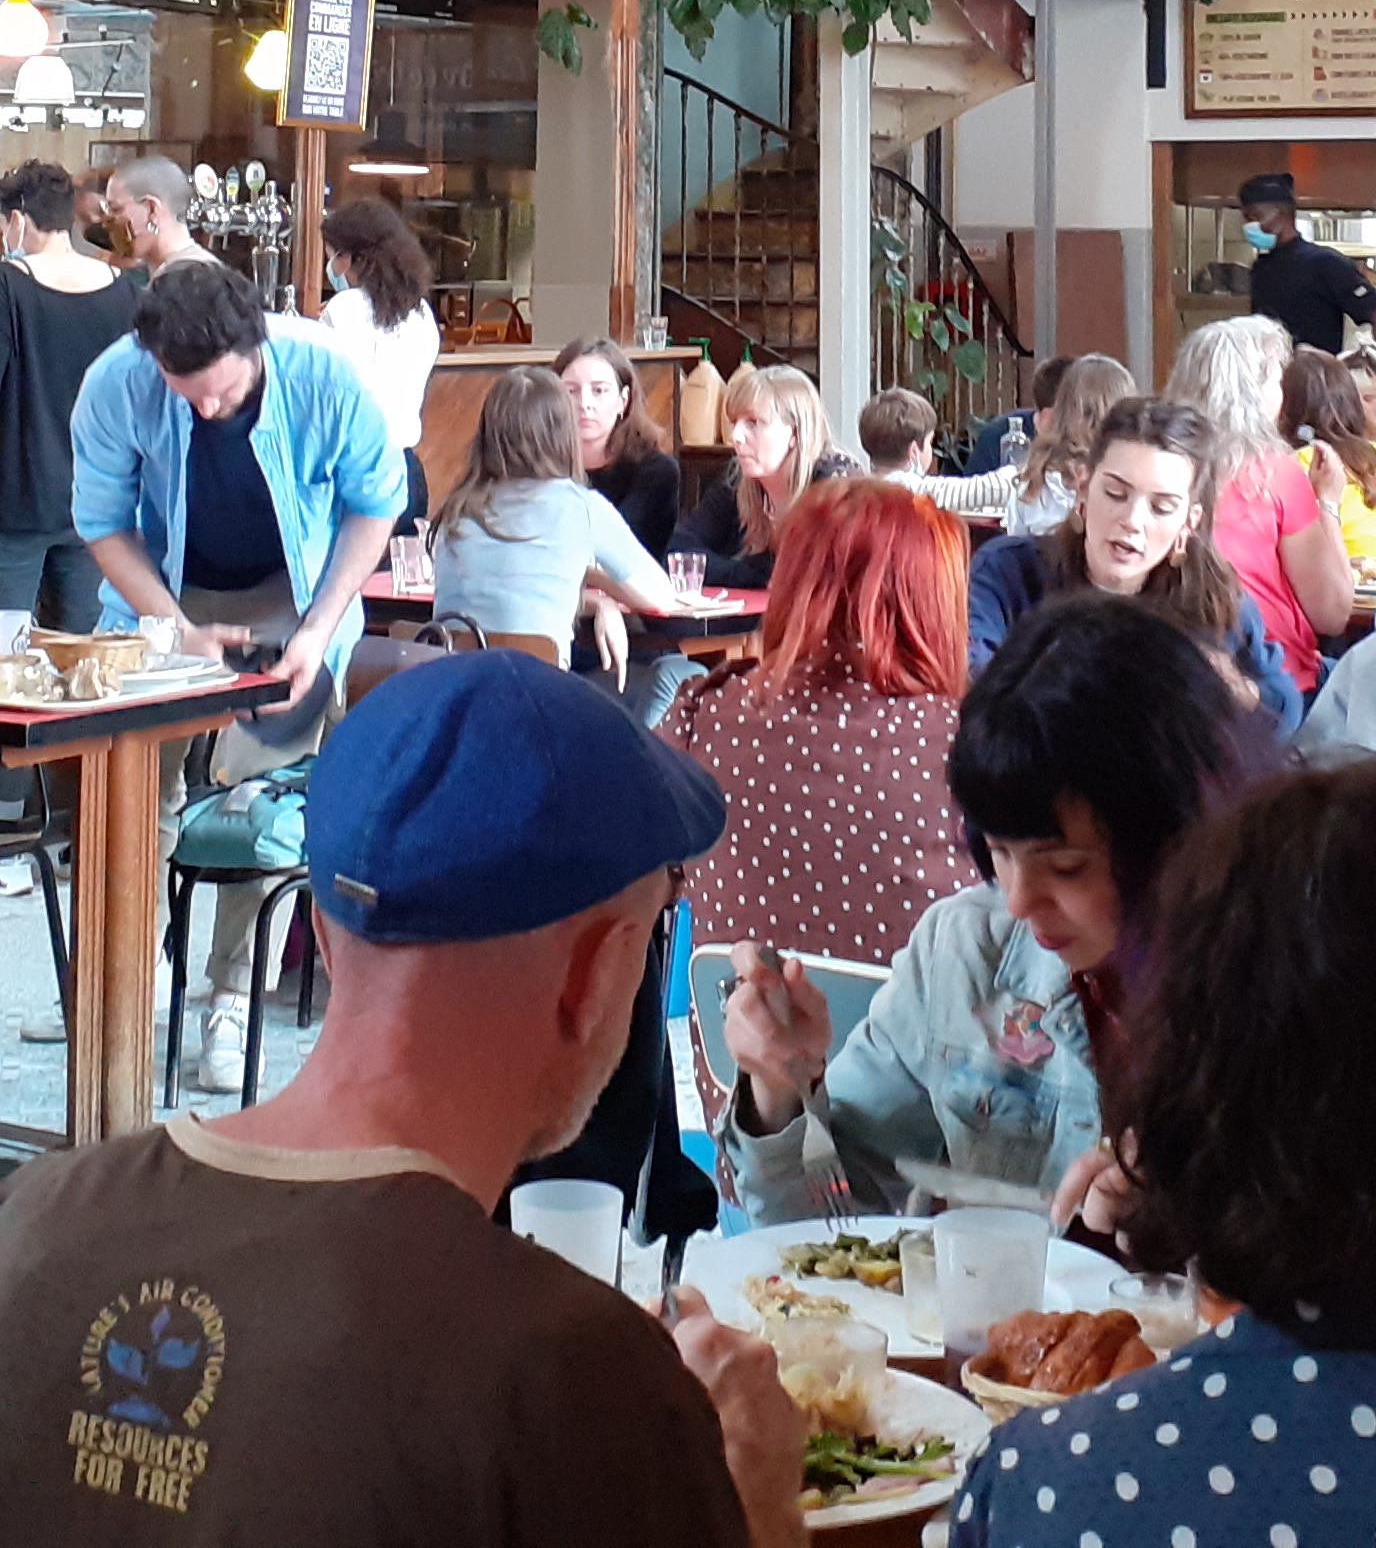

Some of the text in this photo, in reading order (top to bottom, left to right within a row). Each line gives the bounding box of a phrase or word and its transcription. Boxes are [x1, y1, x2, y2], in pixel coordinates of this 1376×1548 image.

[139, 1277, 175, 1305] AIR
[67, 1410, 209, 1476] RESOURCES
[74, 1448, 194, 1513] FOR FREE
